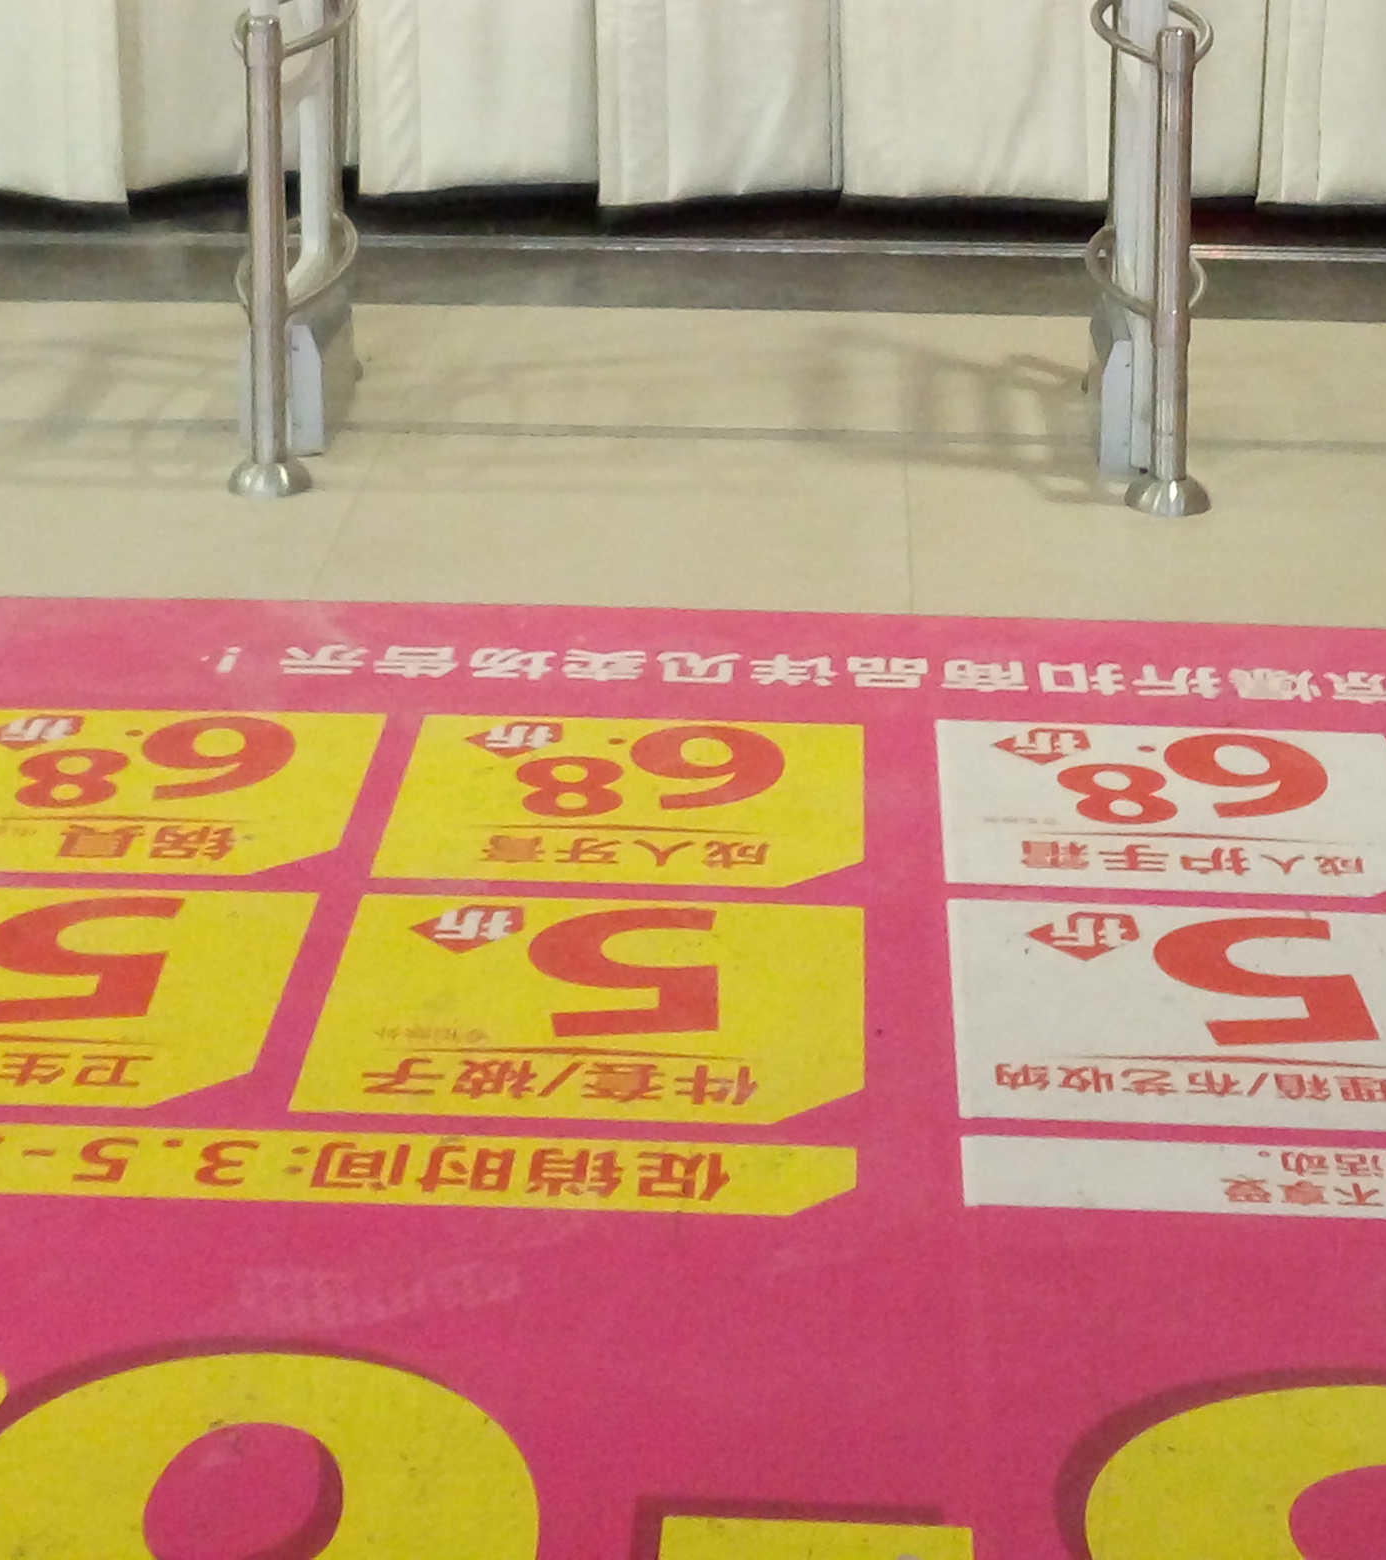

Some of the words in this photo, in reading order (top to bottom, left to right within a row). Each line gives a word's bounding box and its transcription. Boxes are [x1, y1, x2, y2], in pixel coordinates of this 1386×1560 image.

[55, 824, 234, 860] 锅具
[478, 836, 770, 869] 成人牙膏
[1019, 841, 1365, 876] 成人护手霜
[360, 1056, 759, 1105] 件套/被子
